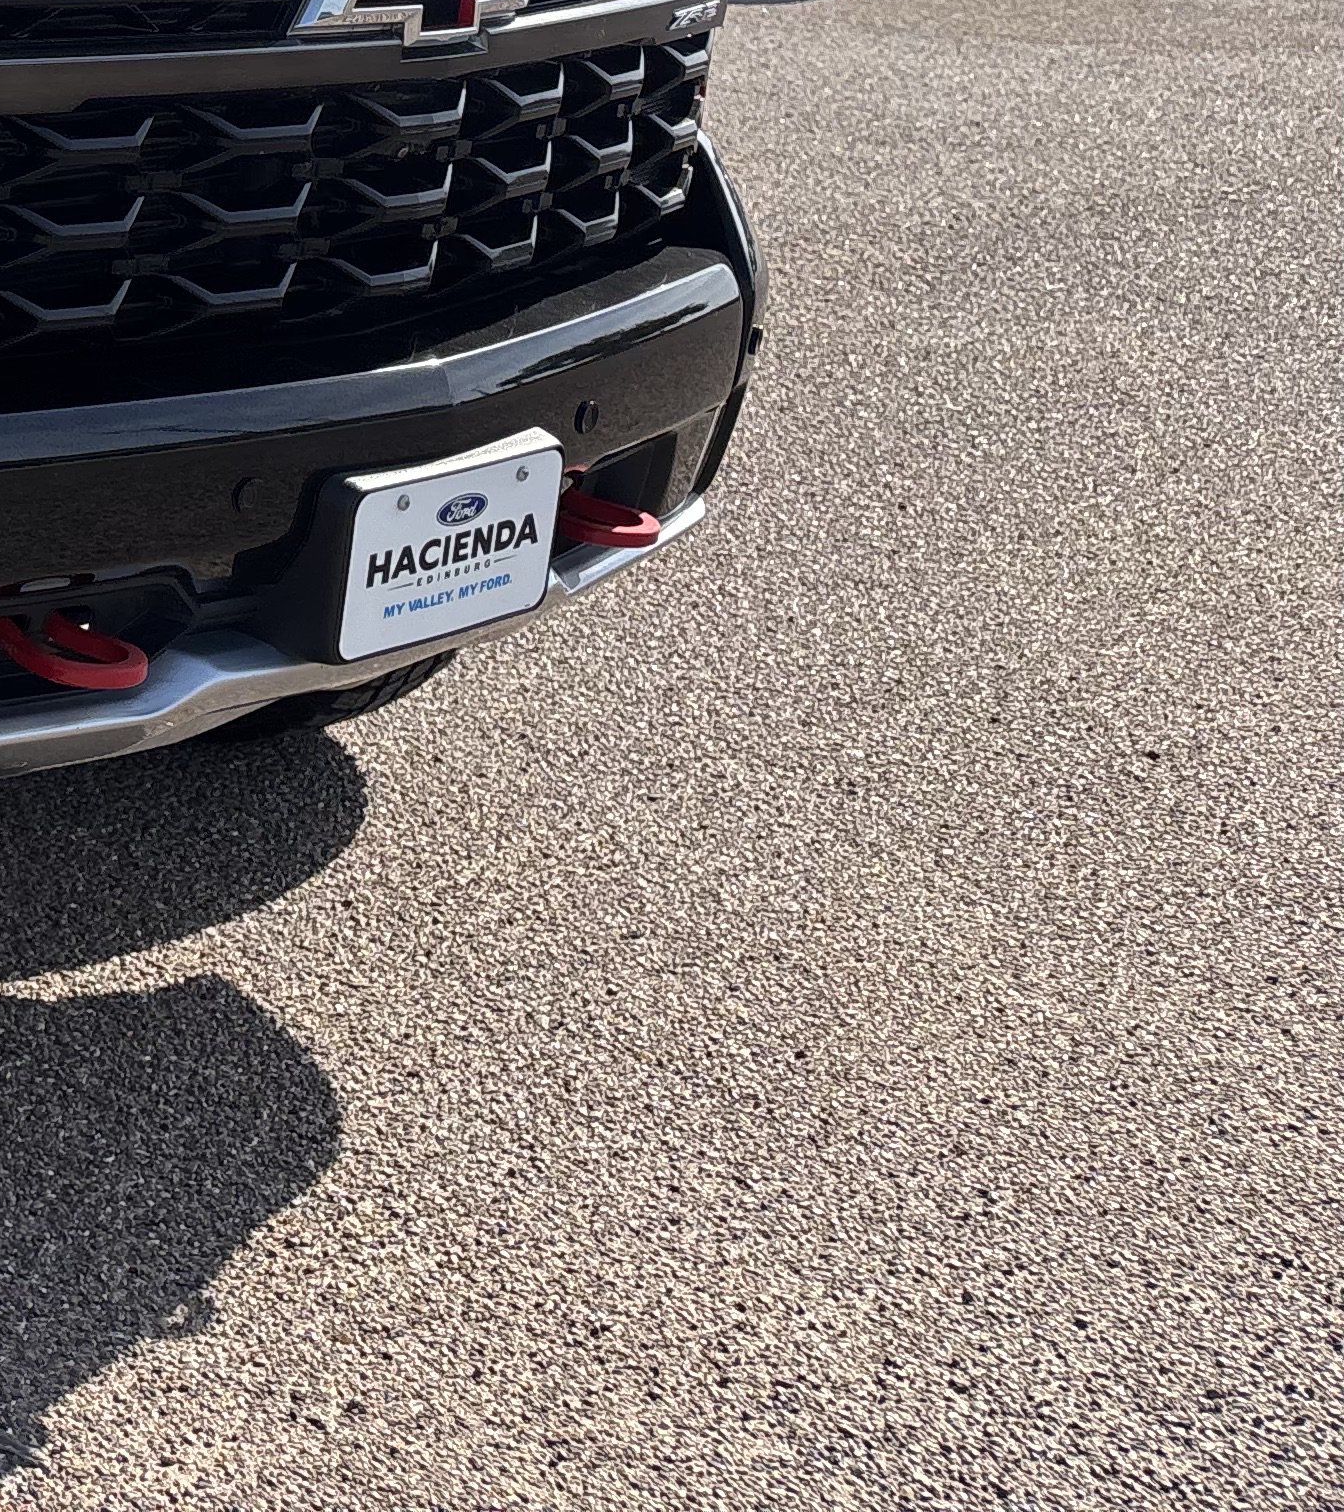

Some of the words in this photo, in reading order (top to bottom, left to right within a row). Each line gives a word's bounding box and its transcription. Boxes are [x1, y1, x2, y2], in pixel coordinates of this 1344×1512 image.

[446, 496, 478, 522] Ford
[366, 513, 539, 588] HACIENDA
[416, 559, 491, 587] EDINBURG
[383, 602, 405, 619] MY
[458, 582, 479, 599] MY
